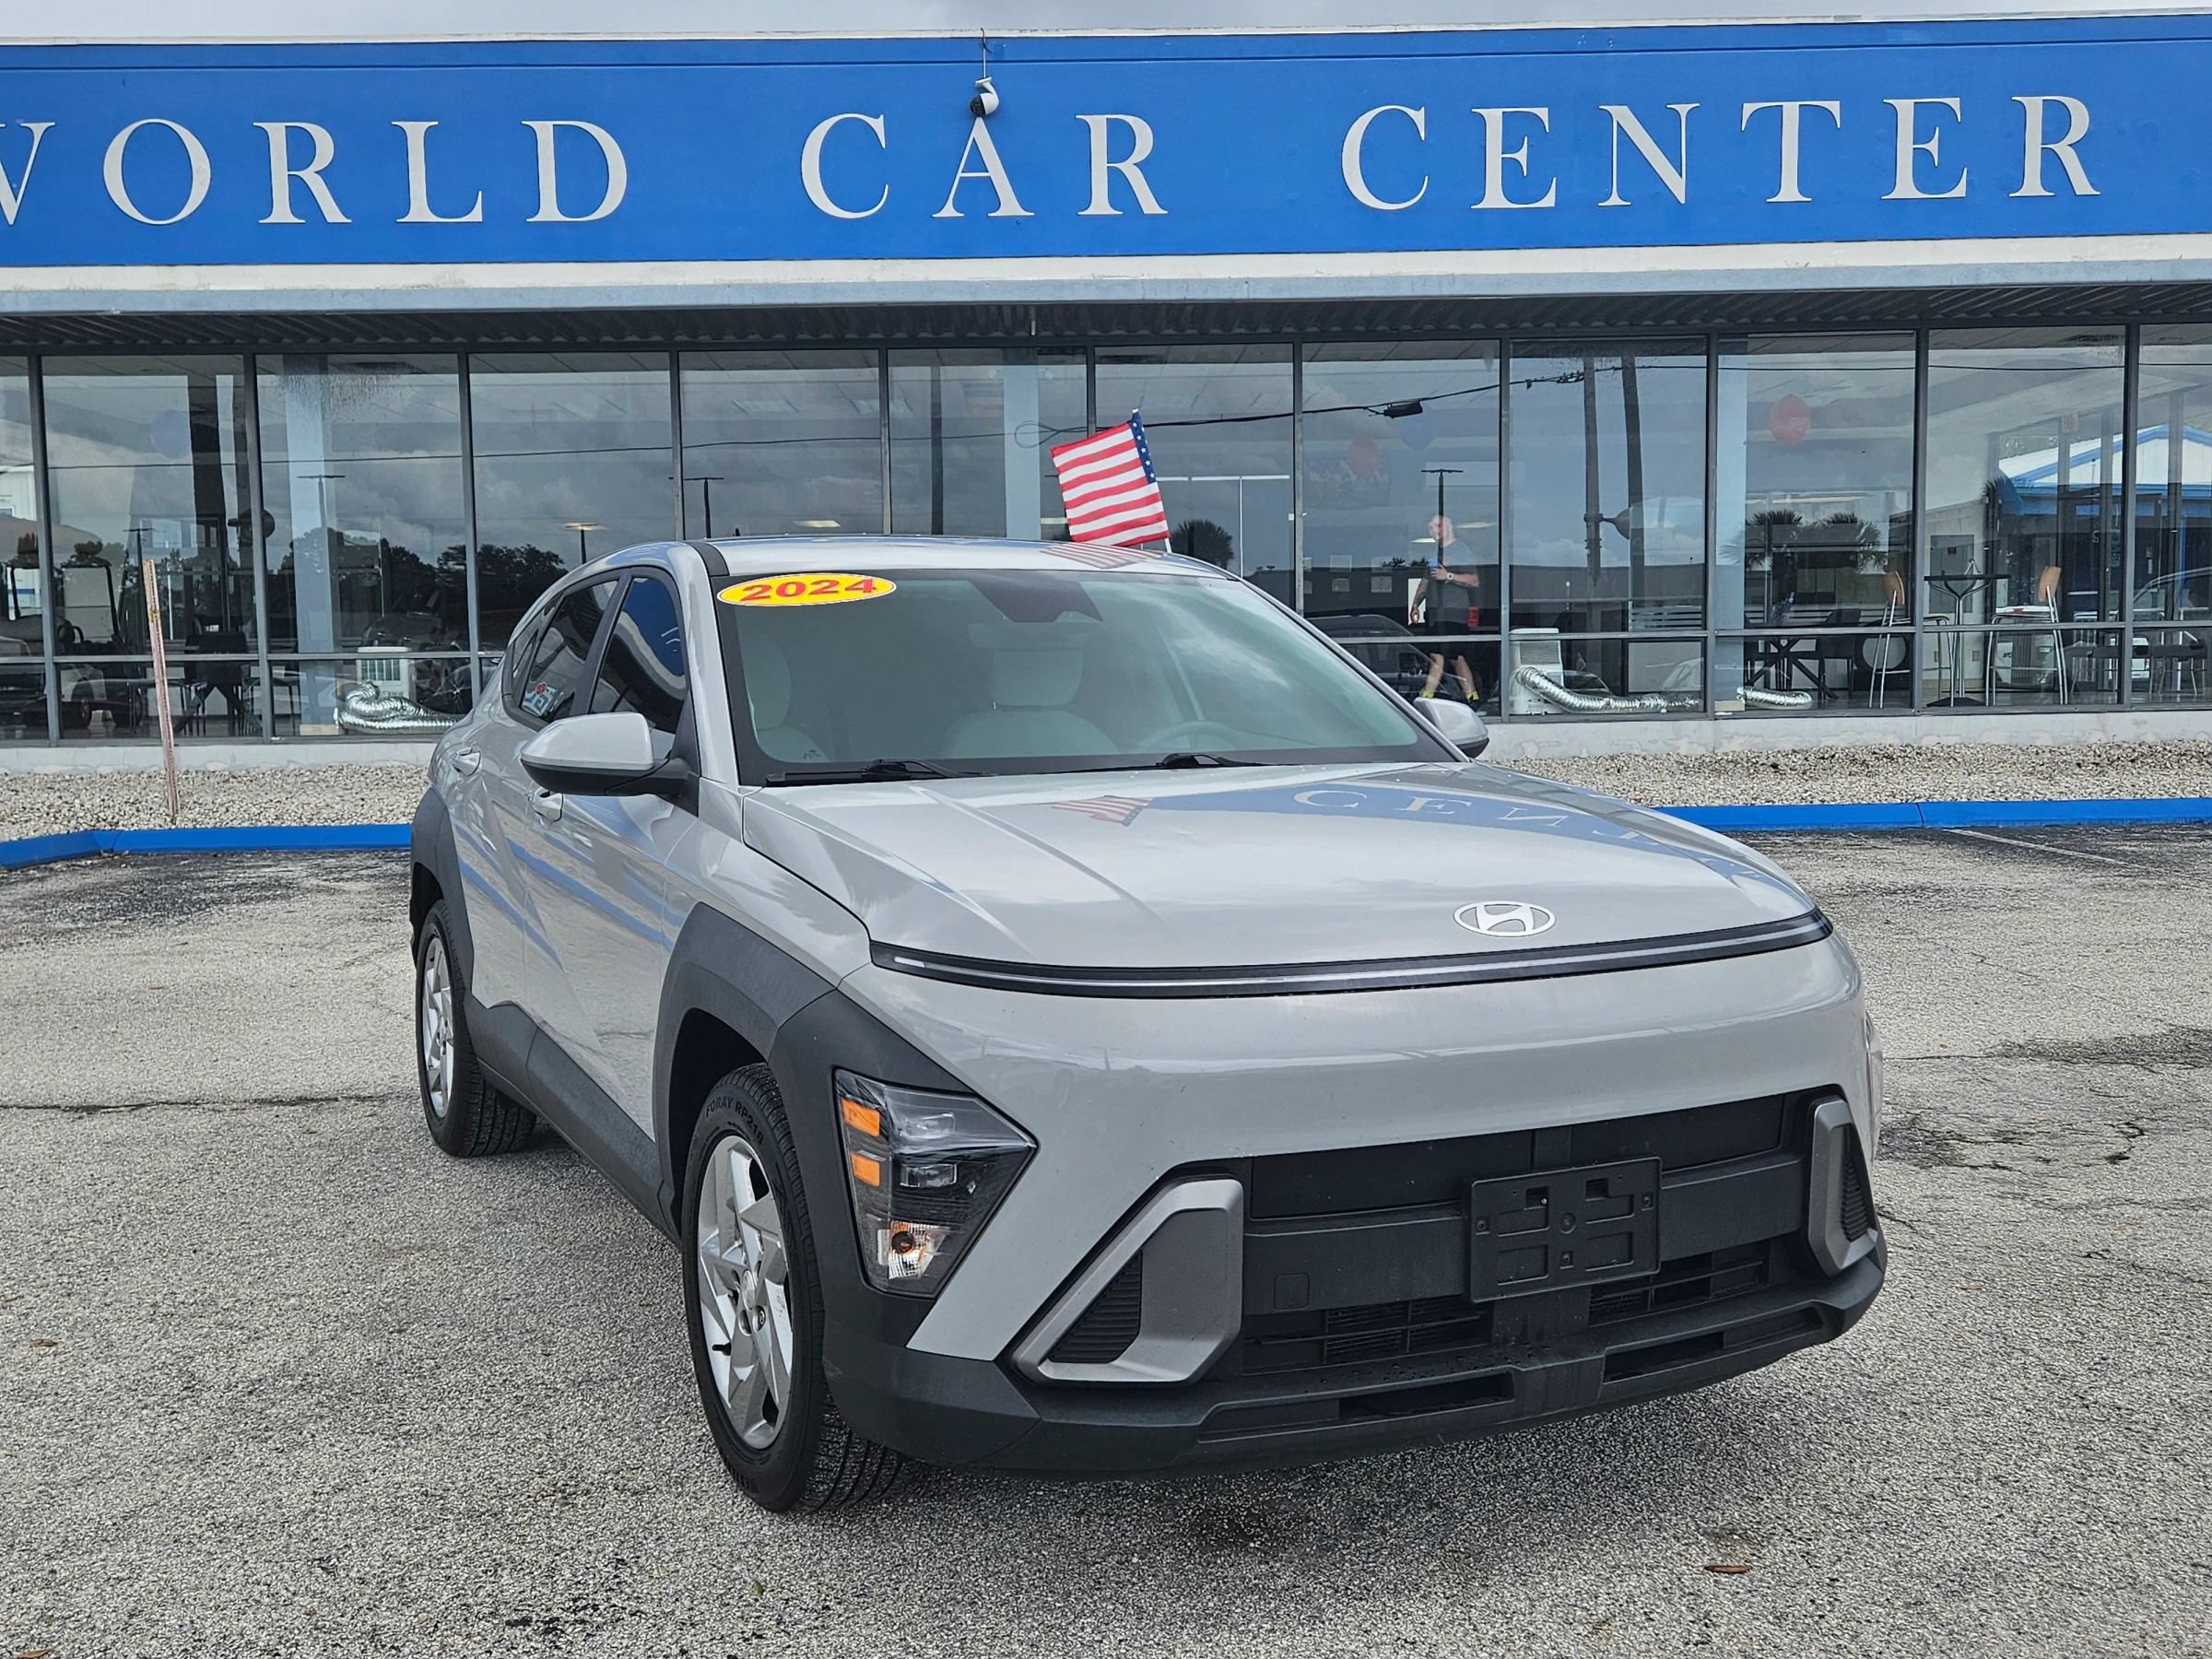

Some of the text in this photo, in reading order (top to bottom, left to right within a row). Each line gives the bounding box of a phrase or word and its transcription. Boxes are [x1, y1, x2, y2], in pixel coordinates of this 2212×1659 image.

[801, 112, 1169, 219] CAR
[1342, 95, 2100, 210] CENTER
[740, 578, 877, 602] 2024
